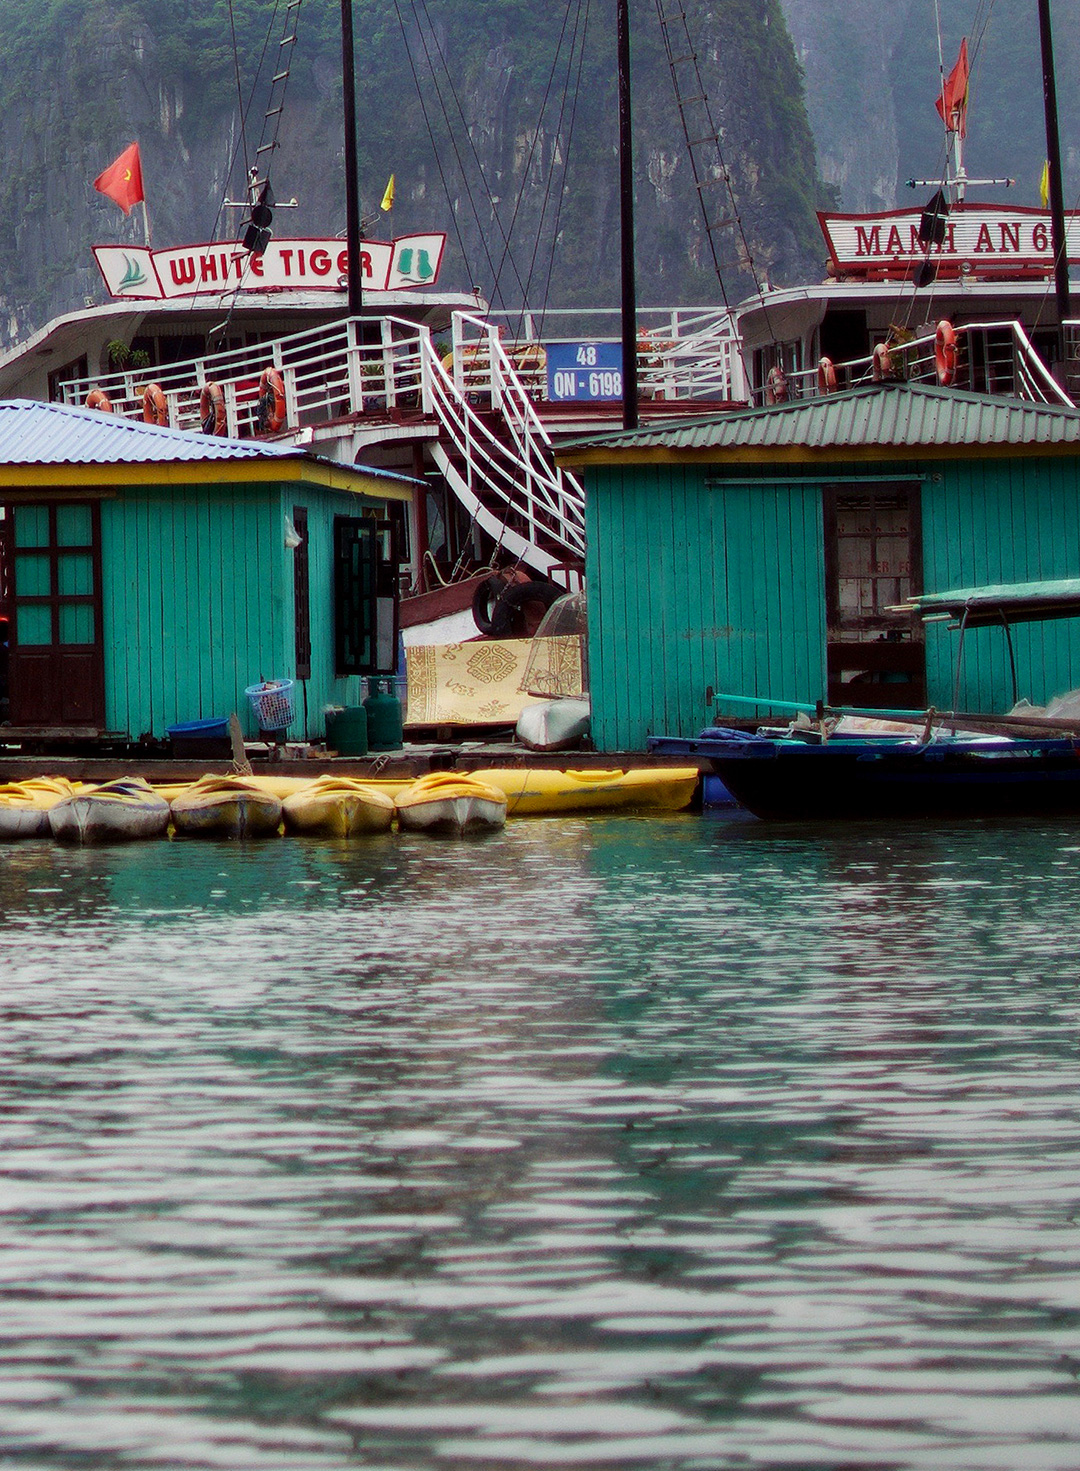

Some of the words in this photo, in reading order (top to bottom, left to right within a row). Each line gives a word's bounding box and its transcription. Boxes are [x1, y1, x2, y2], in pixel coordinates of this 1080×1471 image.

[974, 222, 1021, 253] AN
[170, 251, 264, 286] WHITE
[279, 249, 373, 278] TIGER
[576, 346, 597, 366] 48
[554, 372, 576, 398] QN
[589, 372, 623, 396] 6198
